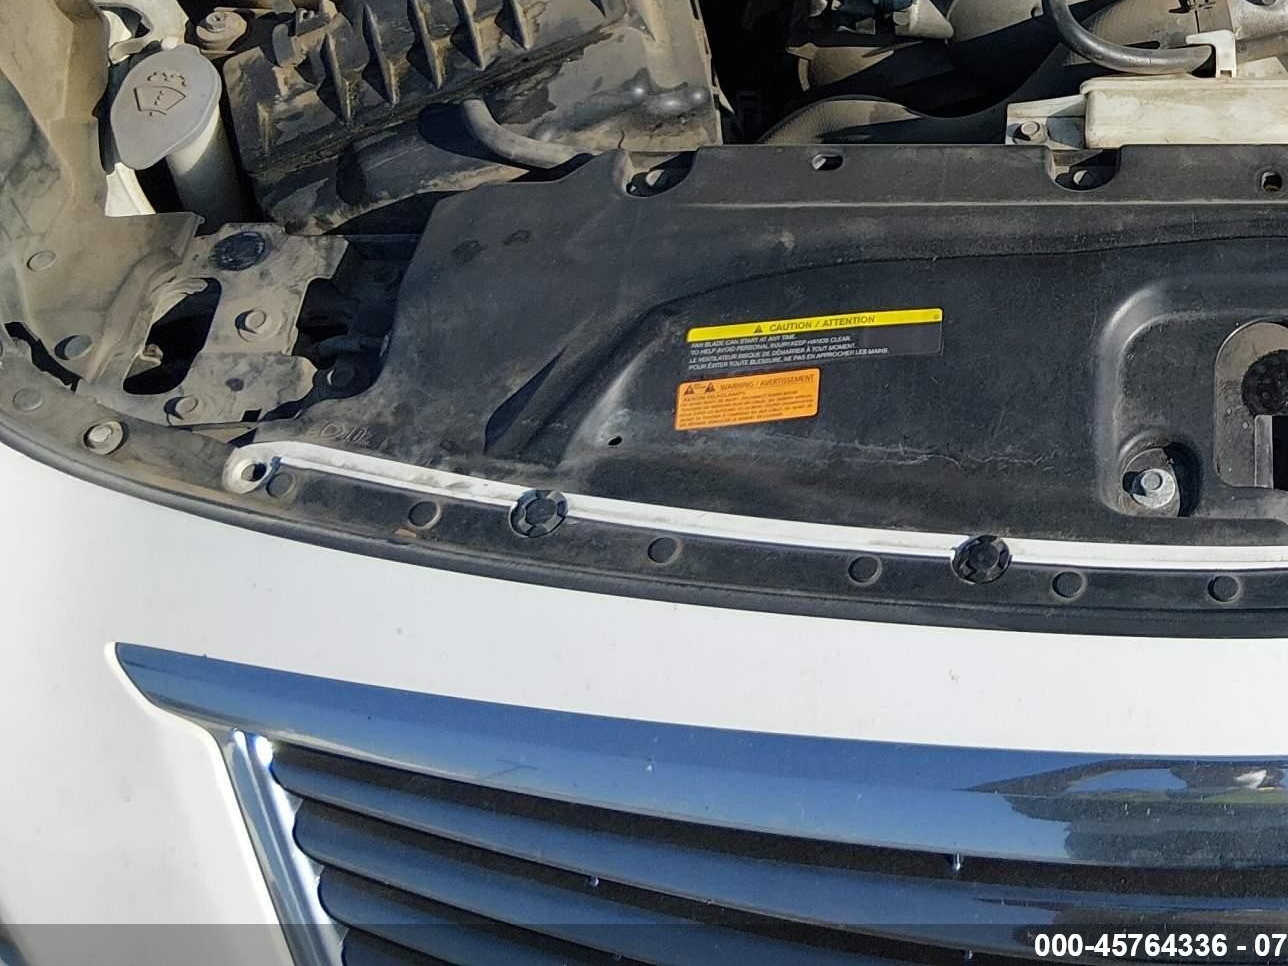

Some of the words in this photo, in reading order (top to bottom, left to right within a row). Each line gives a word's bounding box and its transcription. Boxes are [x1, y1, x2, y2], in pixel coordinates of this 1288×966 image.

[769, 320, 812, 332] CAUTION
[822, 315, 876, 328] ATTENTION
[716, 345, 736, 354] AVOID
[737, 343, 769, 353] PERSONAL
[807, 337, 829, 346] HANDS
[812, 344, 828, 352] TOUT
[688, 363, 707, 371] POUR
[729, 359, 749, 367] TOUTE
[793, 354, 807, 362] PAS
[807, 353, 817, 361] EN
[817, 349, 855, 359] APPROCHER
[720, 381, 754, 391] WARNING
[760, 374, 815, 387] AVERTISSEMENT
